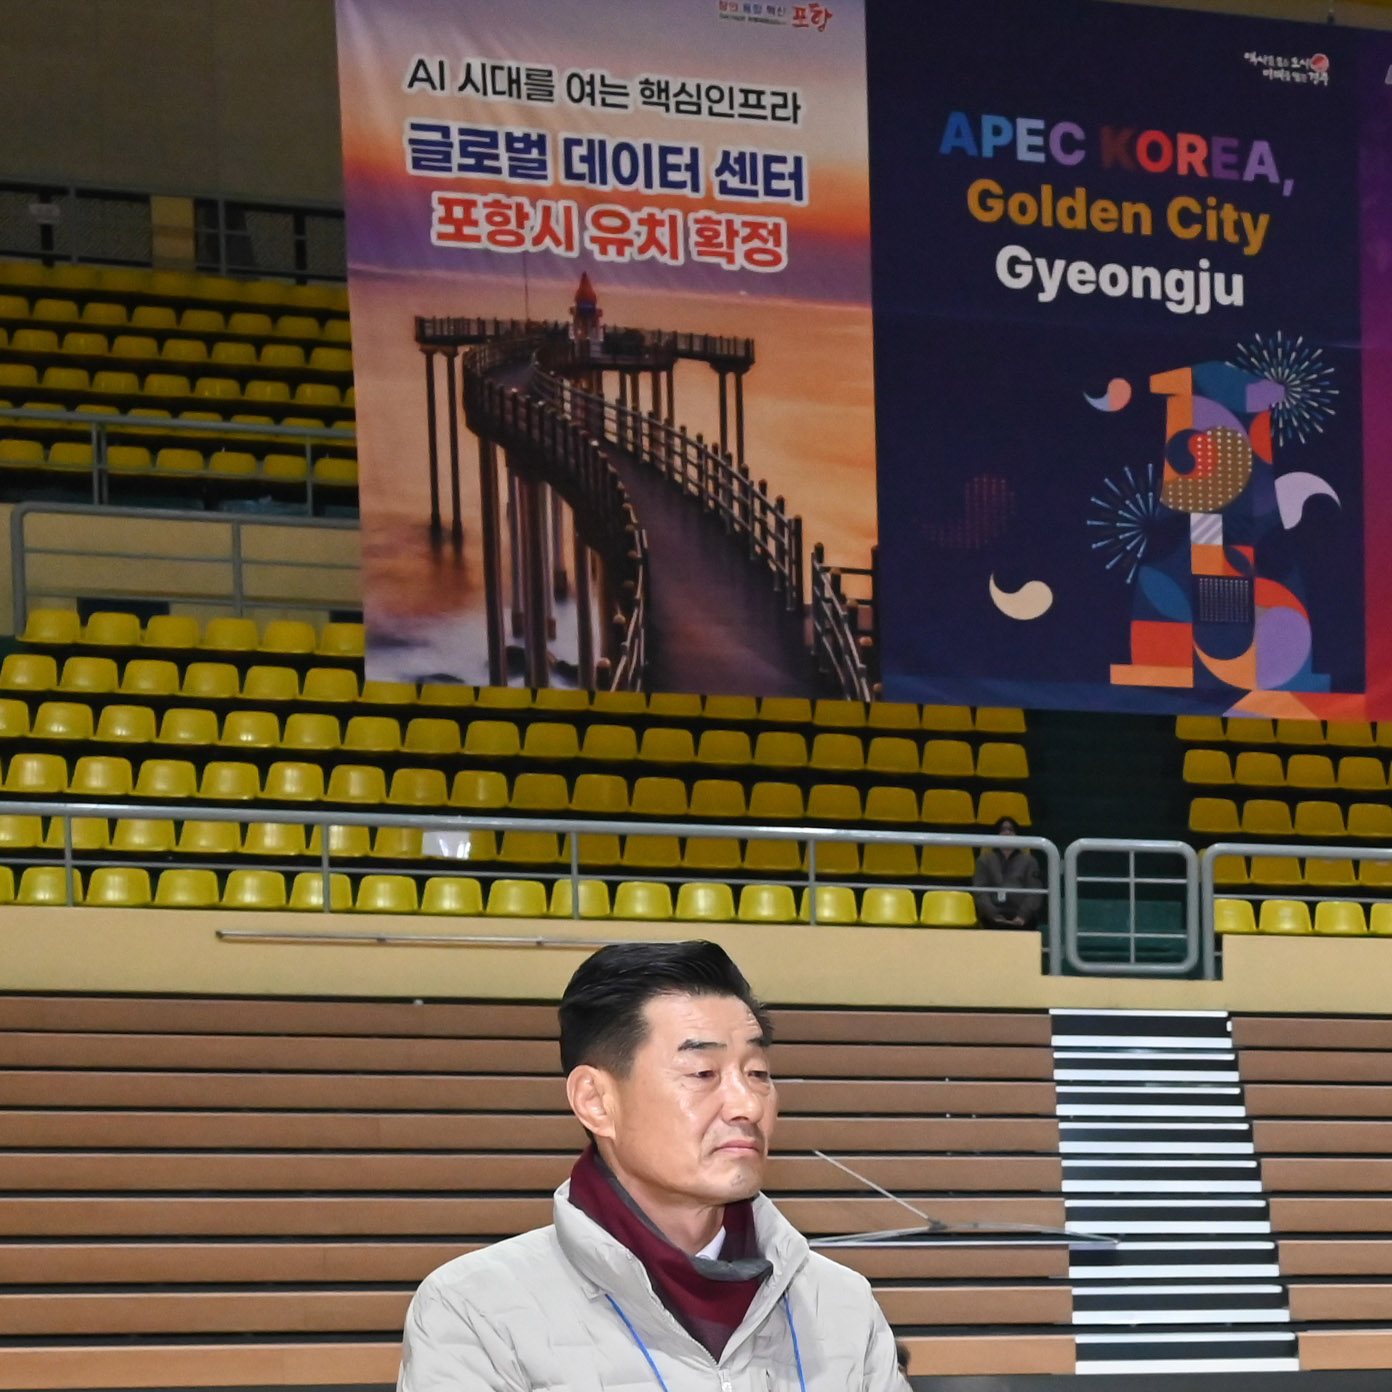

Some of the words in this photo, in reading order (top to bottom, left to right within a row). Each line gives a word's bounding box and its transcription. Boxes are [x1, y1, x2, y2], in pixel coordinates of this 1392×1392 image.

[792, 2, 833, 32] 포항
[407, 59, 445, 92] AI
[458, 61, 556, 103] 시대를
[566, 72, 631, 110] 여는
[638, 77, 801, 124] 핵심인프라
[407, 123, 548, 181] 글로벌
[563, 137, 701, 194] 데이터
[713, 148, 805, 202] 센터
[939, 110, 1086, 167] APEC
[1100, 124, 1295, 197] KOREA,
[435, 195, 574, 254] 포항시
[587, 209, 680, 262] 유치
[694, 216, 786, 269] 확정
[967, 178, 1152, 237] Golden
[1166, 196, 1270, 257] City
[995, 244, 1244, 315] Gyeongju
